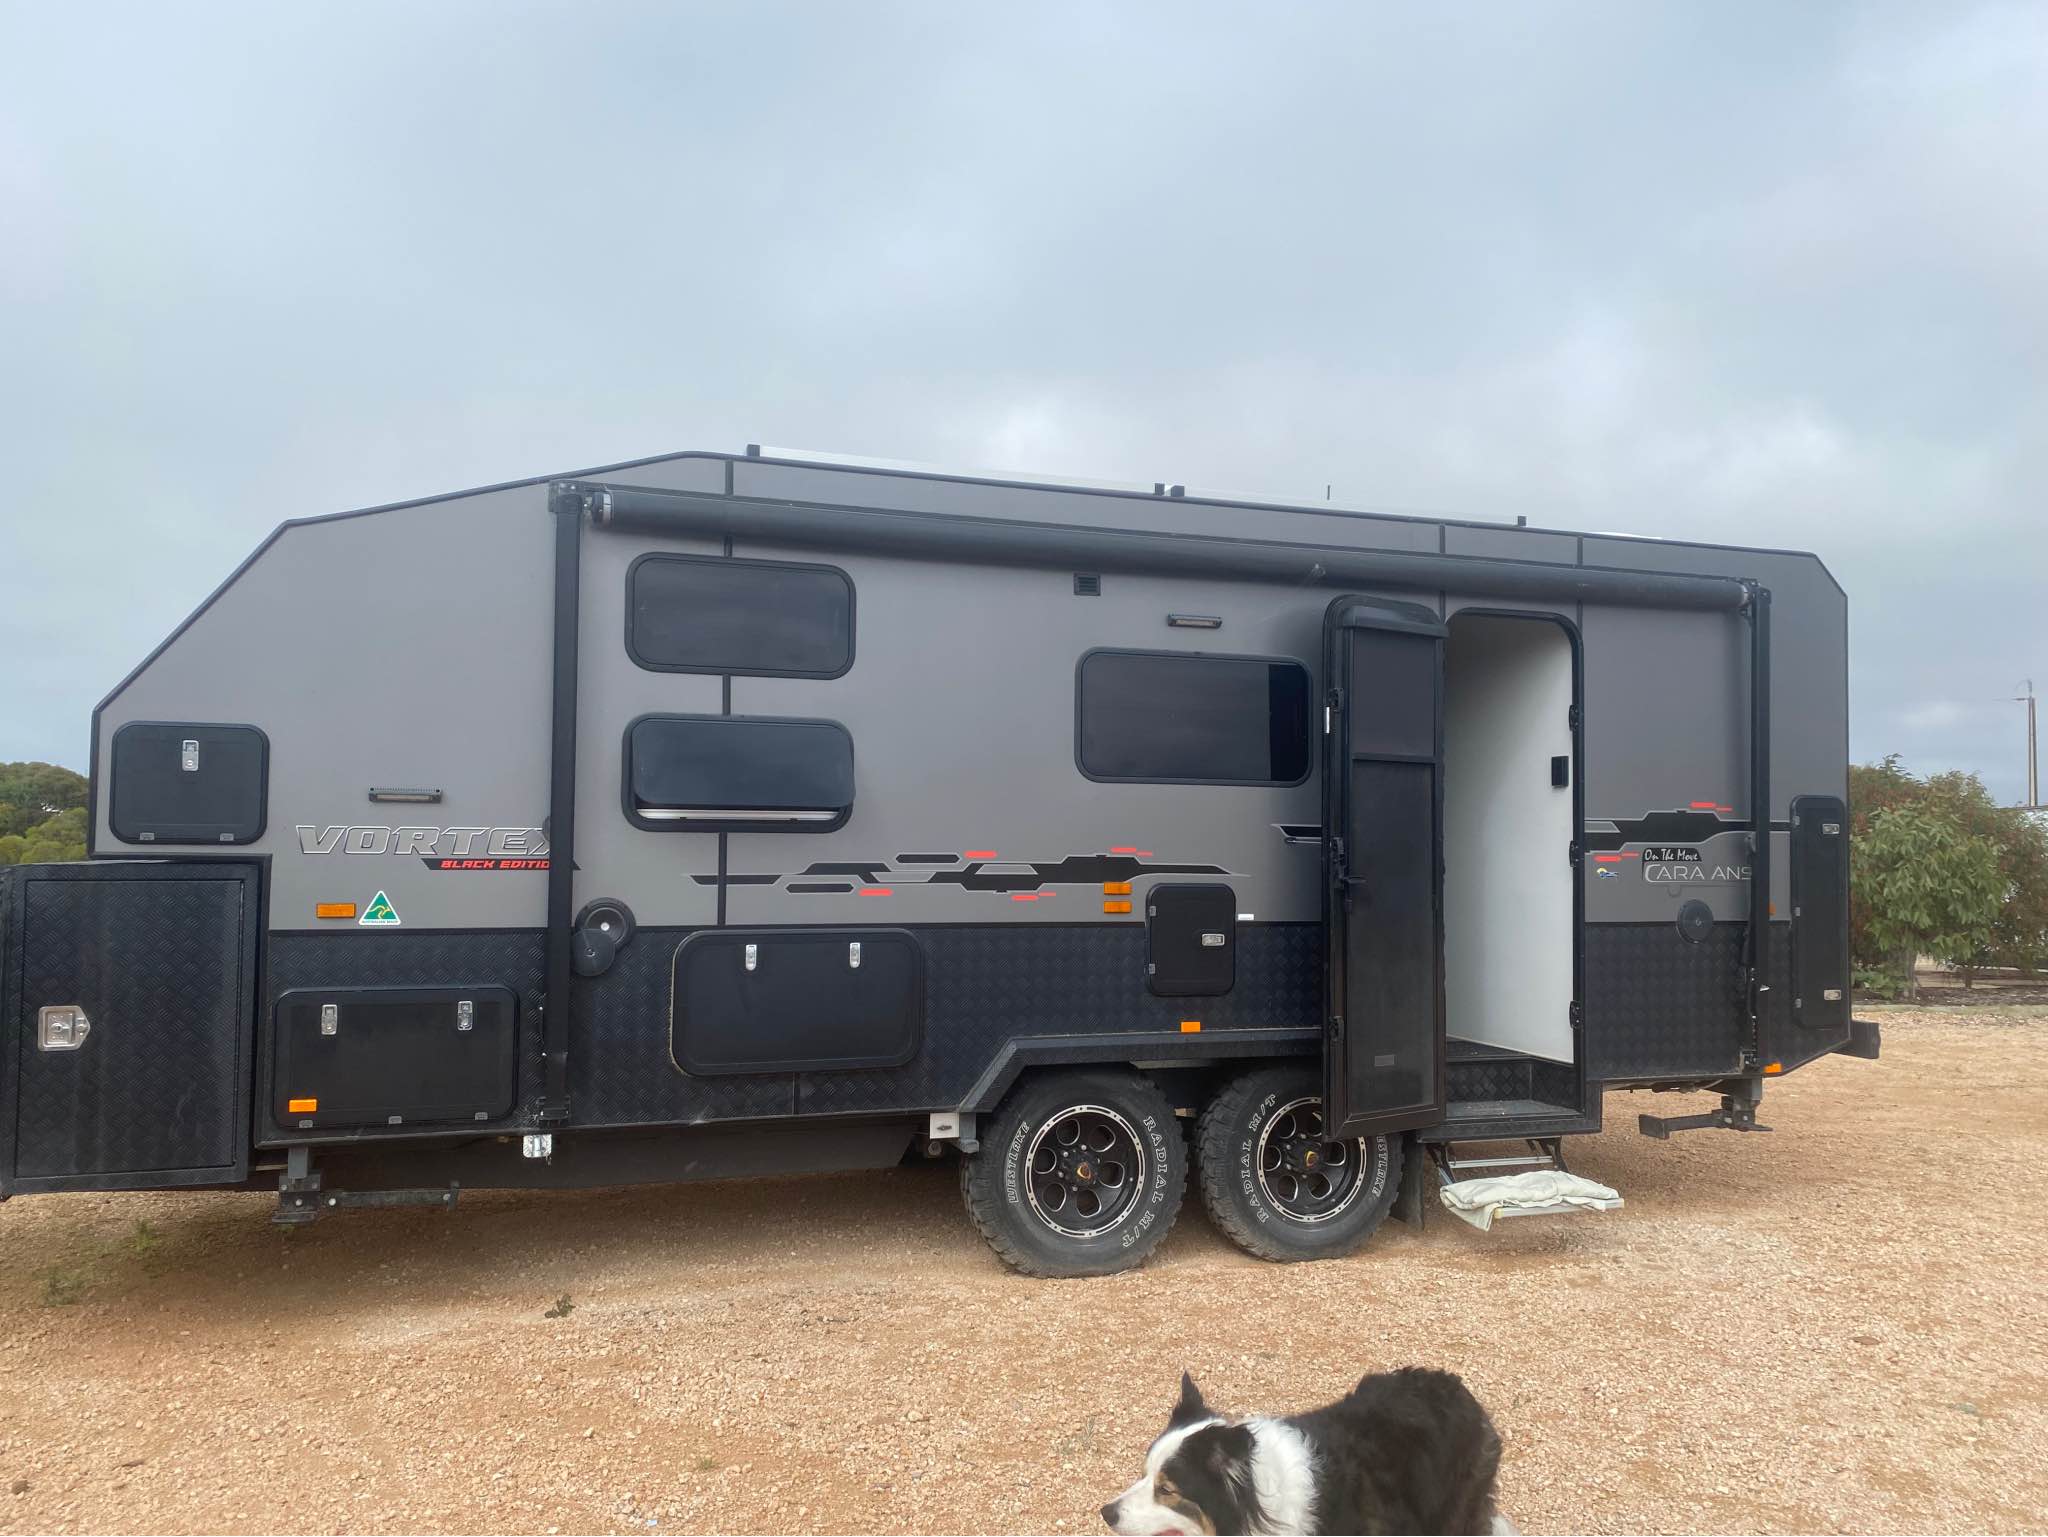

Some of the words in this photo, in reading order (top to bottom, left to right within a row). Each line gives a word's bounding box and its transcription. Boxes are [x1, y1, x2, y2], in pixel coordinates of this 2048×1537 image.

[440, 860, 496, 869] BLACK
[499, 860, 550, 869] EDITIO
[1644, 849, 1659, 861] On
[1661, 848, 1675, 861] The
[1677, 849, 1699, 861] Move
[1645, 864, 1753, 883] CARAANS
[1248, 1093, 1277, 1132] M/T
[1006, 1121, 1030, 1203] WESTLAKE
[1143, 1115, 1168, 1204] RADIAL
[1372, 1135, 1389, 1198] ESTLAKE
[1241, 1139, 1270, 1223] RADIAL
[1122, 1210, 1155, 1248] M/T
